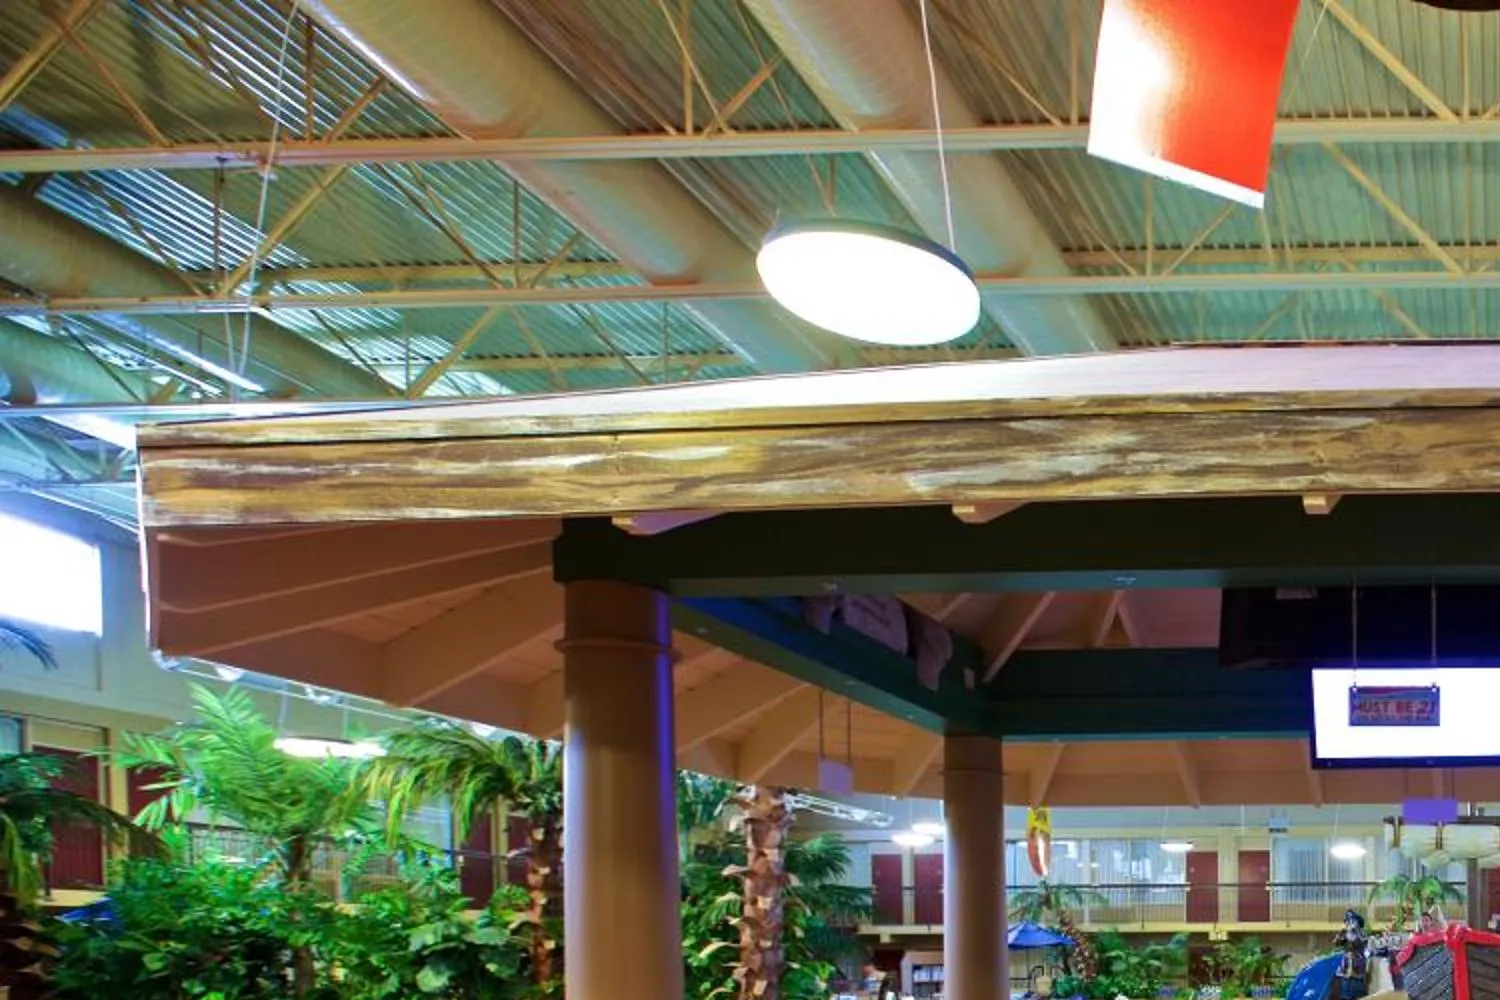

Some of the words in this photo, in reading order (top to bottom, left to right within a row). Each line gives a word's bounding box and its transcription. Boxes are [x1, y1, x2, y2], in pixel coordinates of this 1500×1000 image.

[1352, 700, 1392, 714] MUST
[1395, 700, 1415, 714] BE
[1416, 700, 1437, 714] 21
